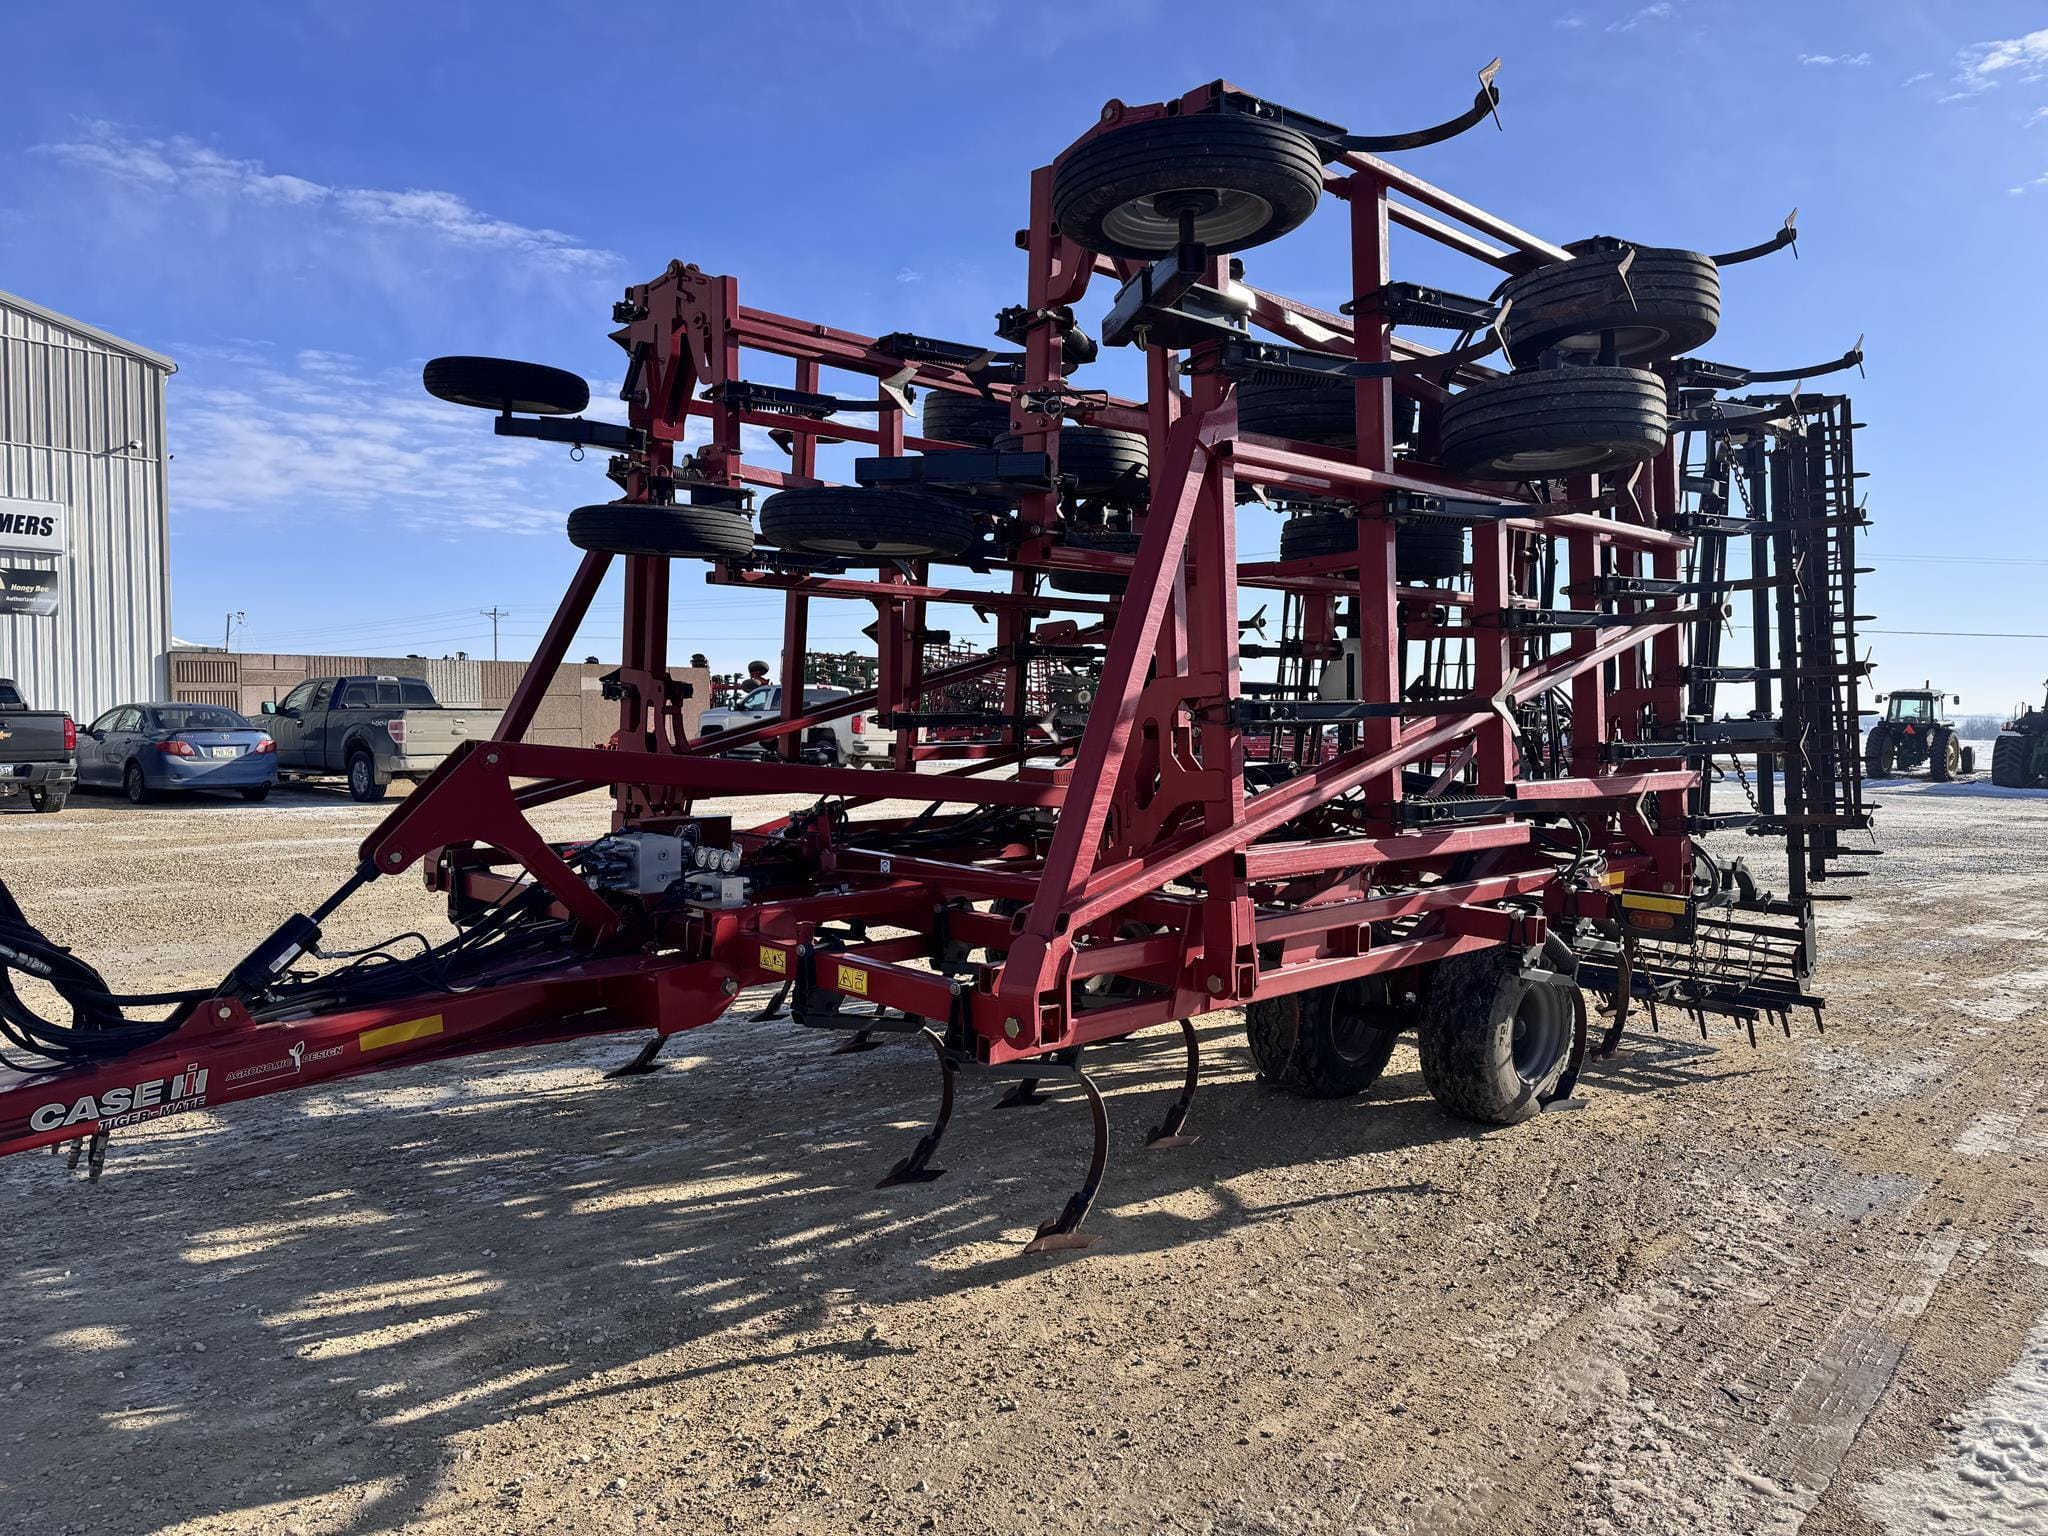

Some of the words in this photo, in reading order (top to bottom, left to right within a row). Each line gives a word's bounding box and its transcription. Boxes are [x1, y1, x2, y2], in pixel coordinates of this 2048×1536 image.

[11, 583, 34, 593] Honey
[35, 585, 50, 593] Bee
[225, 1058, 293, 1082] AGRONOMIC
[301, 1045, 344, 1064] DESIGN
[29, 1078, 164, 1132] CASE
[98, 1095, 206, 1131] TIGER-MATE
